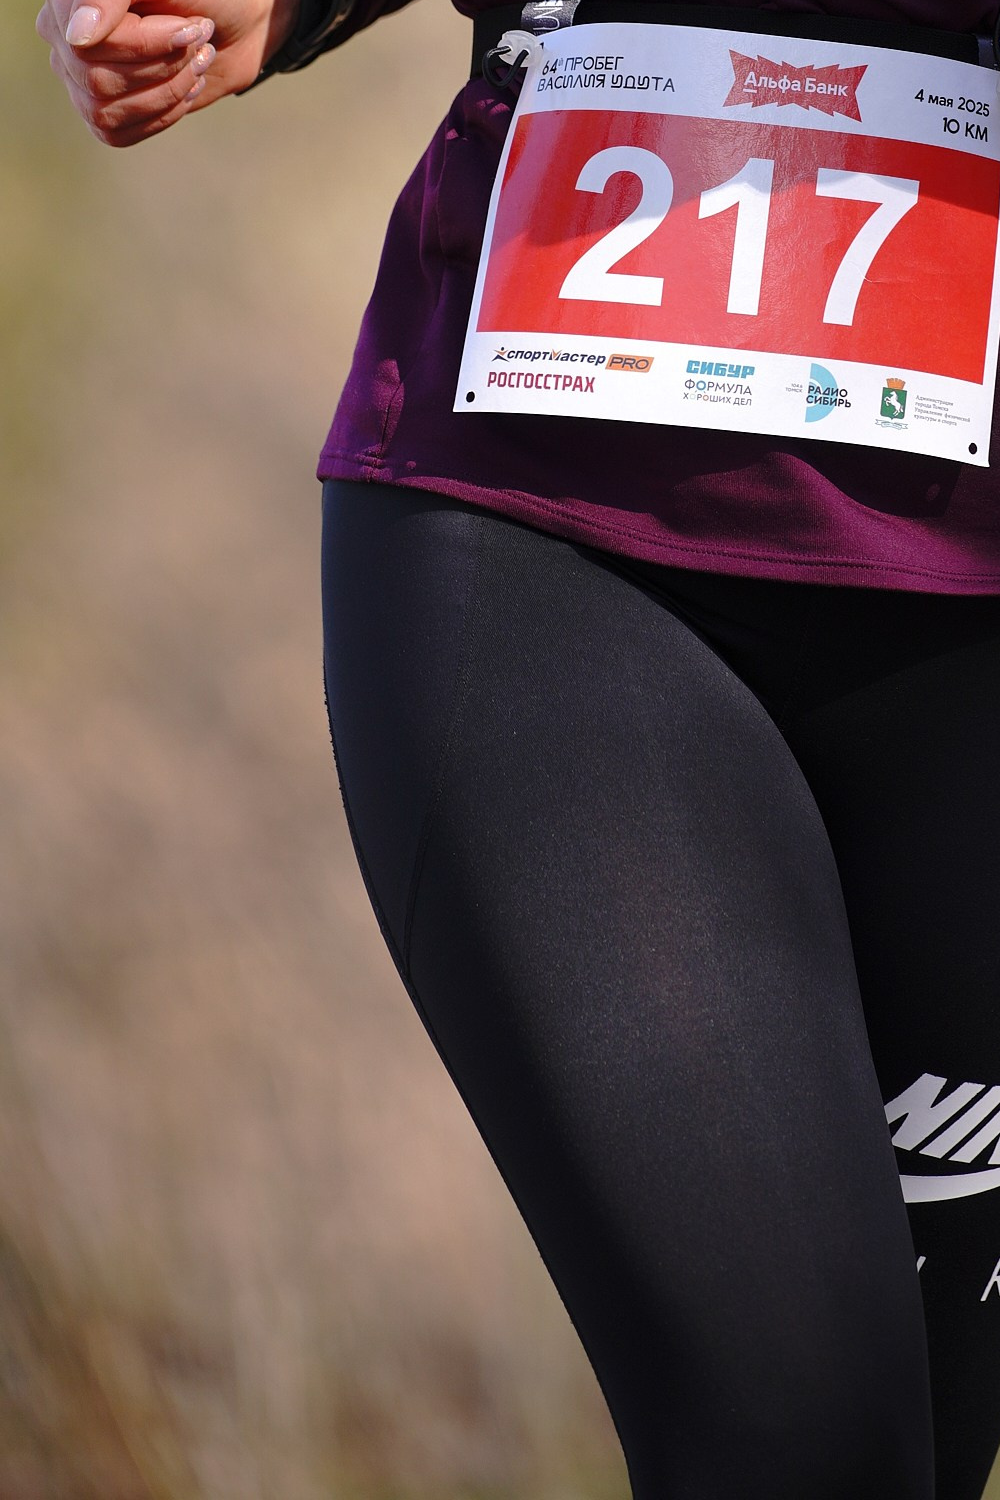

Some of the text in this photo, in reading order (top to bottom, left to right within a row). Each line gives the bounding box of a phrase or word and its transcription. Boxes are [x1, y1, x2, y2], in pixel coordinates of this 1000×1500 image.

[564, 56, 625, 72] ПРОБЕГ
[743, 71, 849, 97] Альфа Банк
[914, 88, 990, 117] 4 мая 2025
[942, 117, 960, 135] 10
[558, 145, 920, 326] 217
[608, 356, 650, 370] PRO
[686, 360, 756, 379] СИБУР
[487, 371, 596, 393] РОСГОССТРАХ
[684, 378, 753, 395] ФОРМУЛА
[683, 392, 752, 406] ХОРОШИХ ДЕЛ
[808, 385, 848, 398] РАДИО
[806, 395, 852, 408] СИБИРЬ
